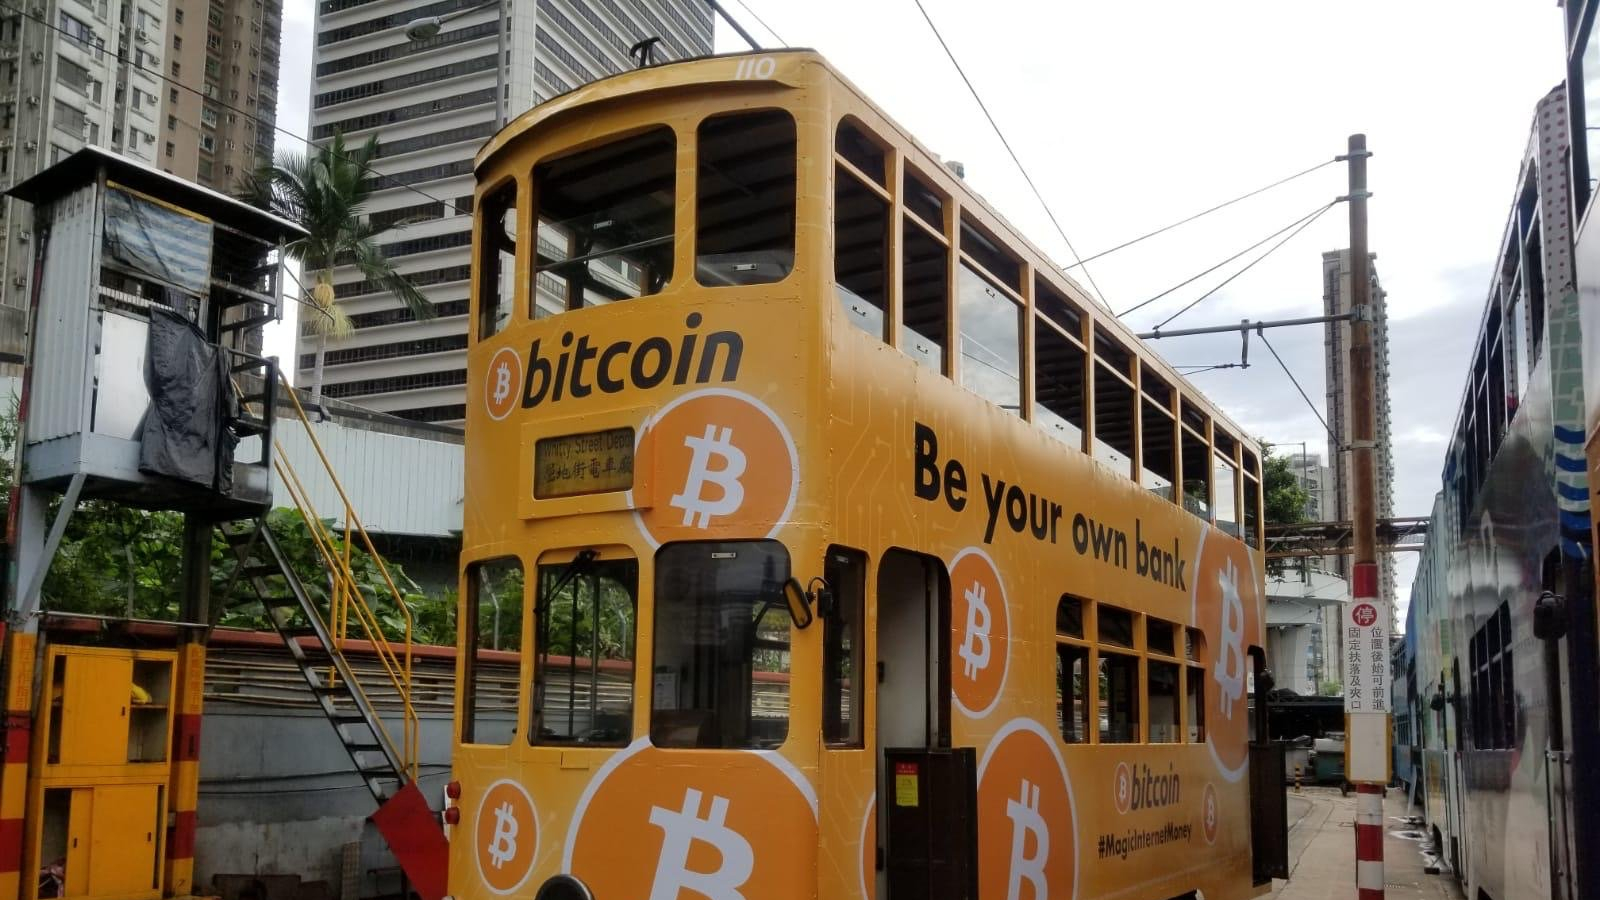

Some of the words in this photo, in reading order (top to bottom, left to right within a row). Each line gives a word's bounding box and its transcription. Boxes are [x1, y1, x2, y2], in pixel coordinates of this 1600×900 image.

[735, 56, 776, 81] 110
[521, 311, 744, 410] bitcoin
[575, 434, 603, 454] Street
[914, 421, 968, 513] Be
[981, 472, 1063, 545] your
[1071, 512, 1128, 571] own
[1135, 518, 1187, 593] bank
[1354, 606, 1375, 624] 停
[1131, 762, 1180, 811] bitcoin
[1098, 822, 1192, 861] #MagicInternetMoney
